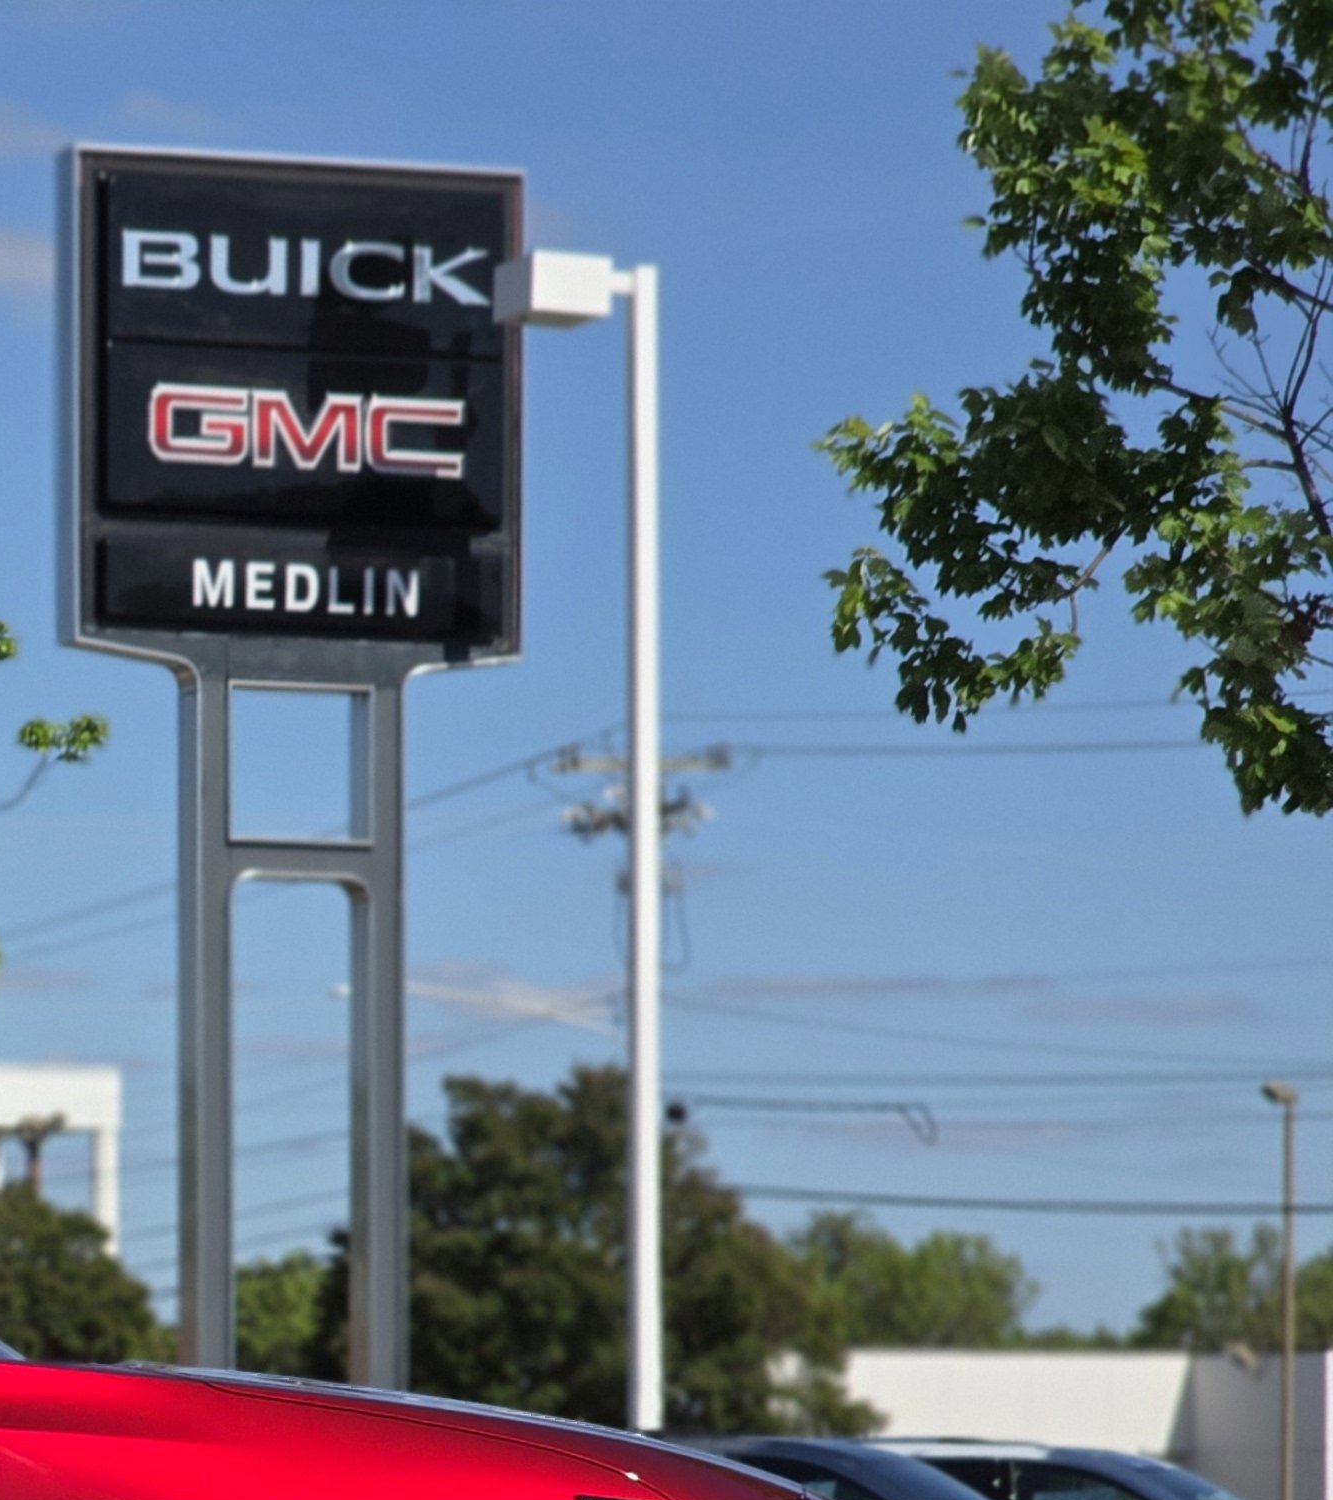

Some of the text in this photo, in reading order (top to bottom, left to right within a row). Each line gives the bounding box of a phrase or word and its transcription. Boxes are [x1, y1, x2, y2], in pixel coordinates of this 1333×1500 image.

[121, 228, 490, 306] BUICK
[148, 381, 465, 479] GMC
[191, 558, 420, 618] MEDLIN
